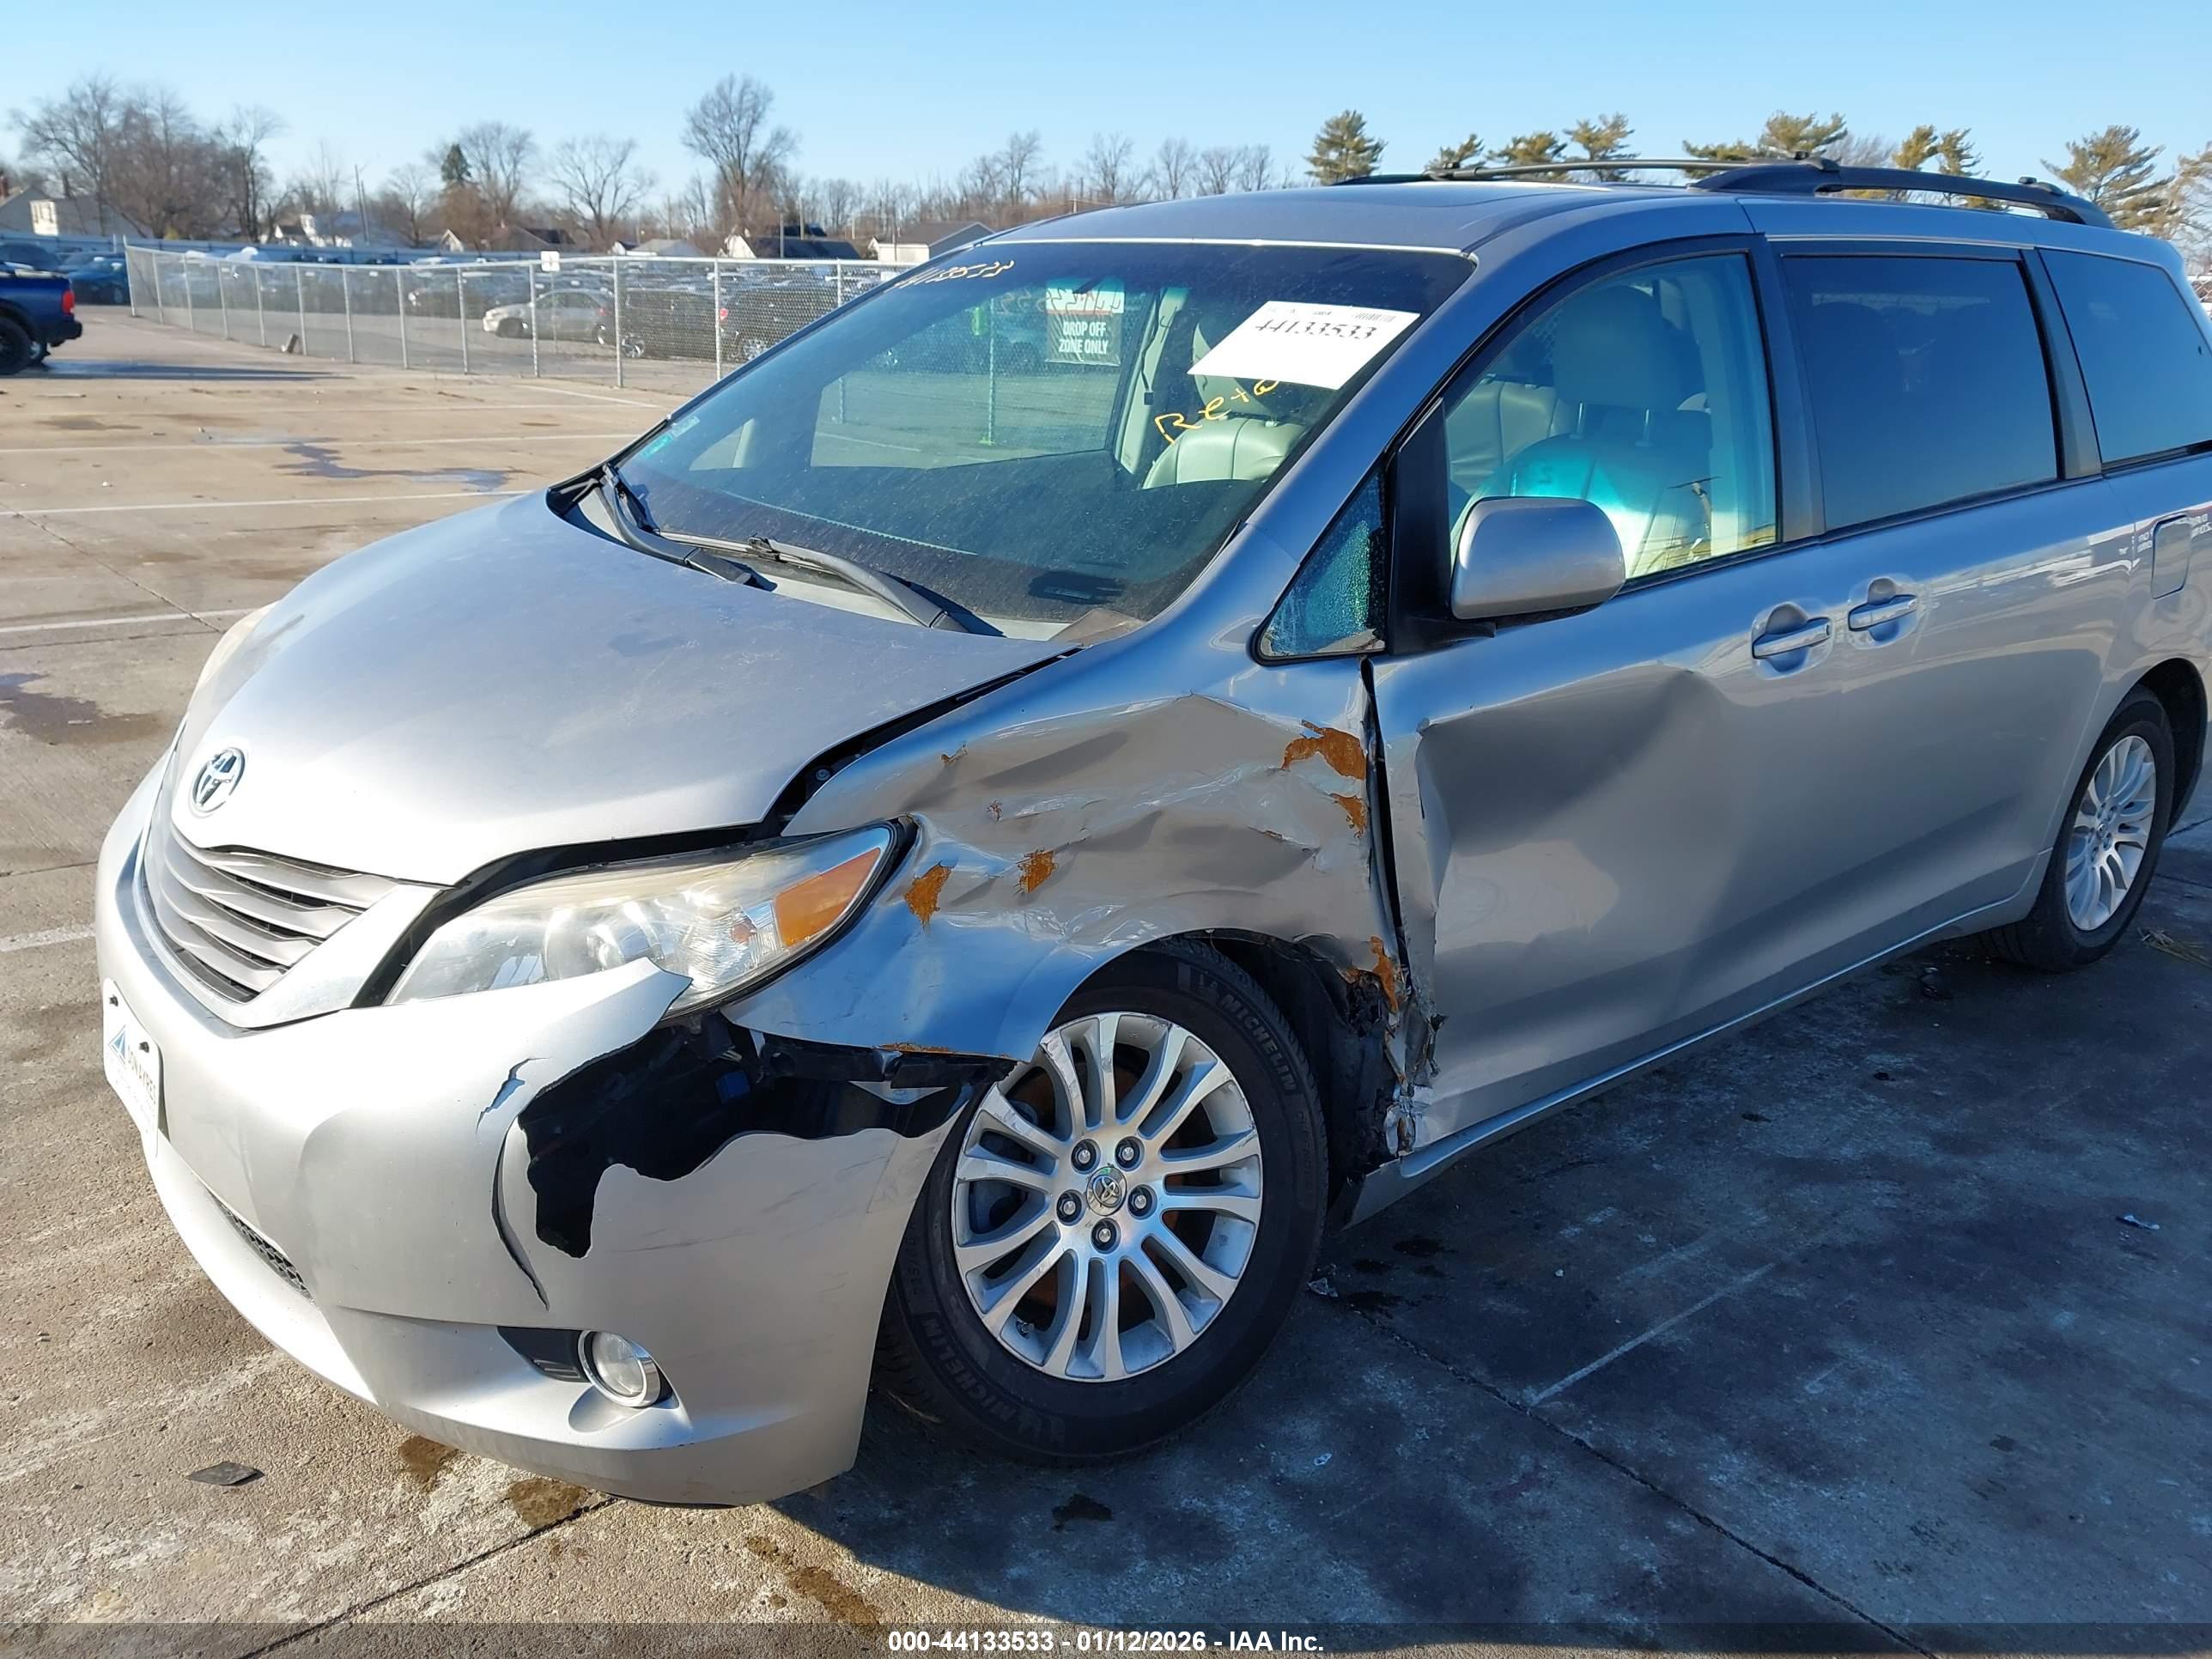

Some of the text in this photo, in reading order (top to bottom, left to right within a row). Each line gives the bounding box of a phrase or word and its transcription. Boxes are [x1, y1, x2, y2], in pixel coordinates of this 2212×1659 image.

[1062, 321, 1107, 337] DROP OFF
[1255, 319, 1378, 339] 44133533
[1058, 338, 1109, 355] ZONE ONLY
[1220, 994, 1297, 1091] MICHELIN
[921, 1318, 1017, 1422] MICHELIN
